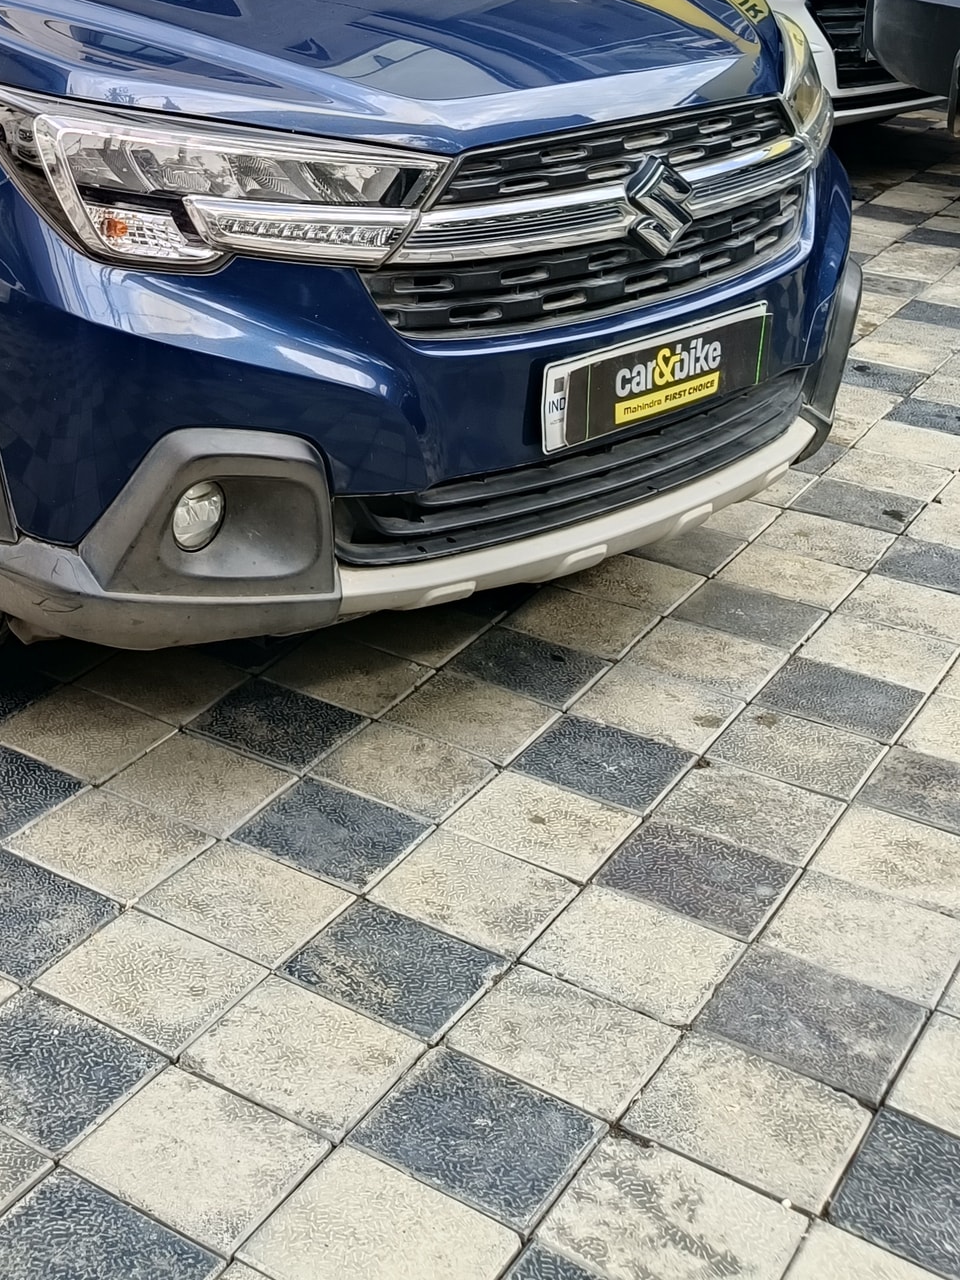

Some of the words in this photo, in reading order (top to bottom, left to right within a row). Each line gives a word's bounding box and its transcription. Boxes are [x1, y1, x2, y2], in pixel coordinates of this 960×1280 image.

[615, 337, 722, 398] car&bike
[548, 397, 566, 414] IND
[623, 398, 663, 416] Mahindra
[664, 388, 688, 403] FIRST
[688, 379, 716, 396] CHOICE
